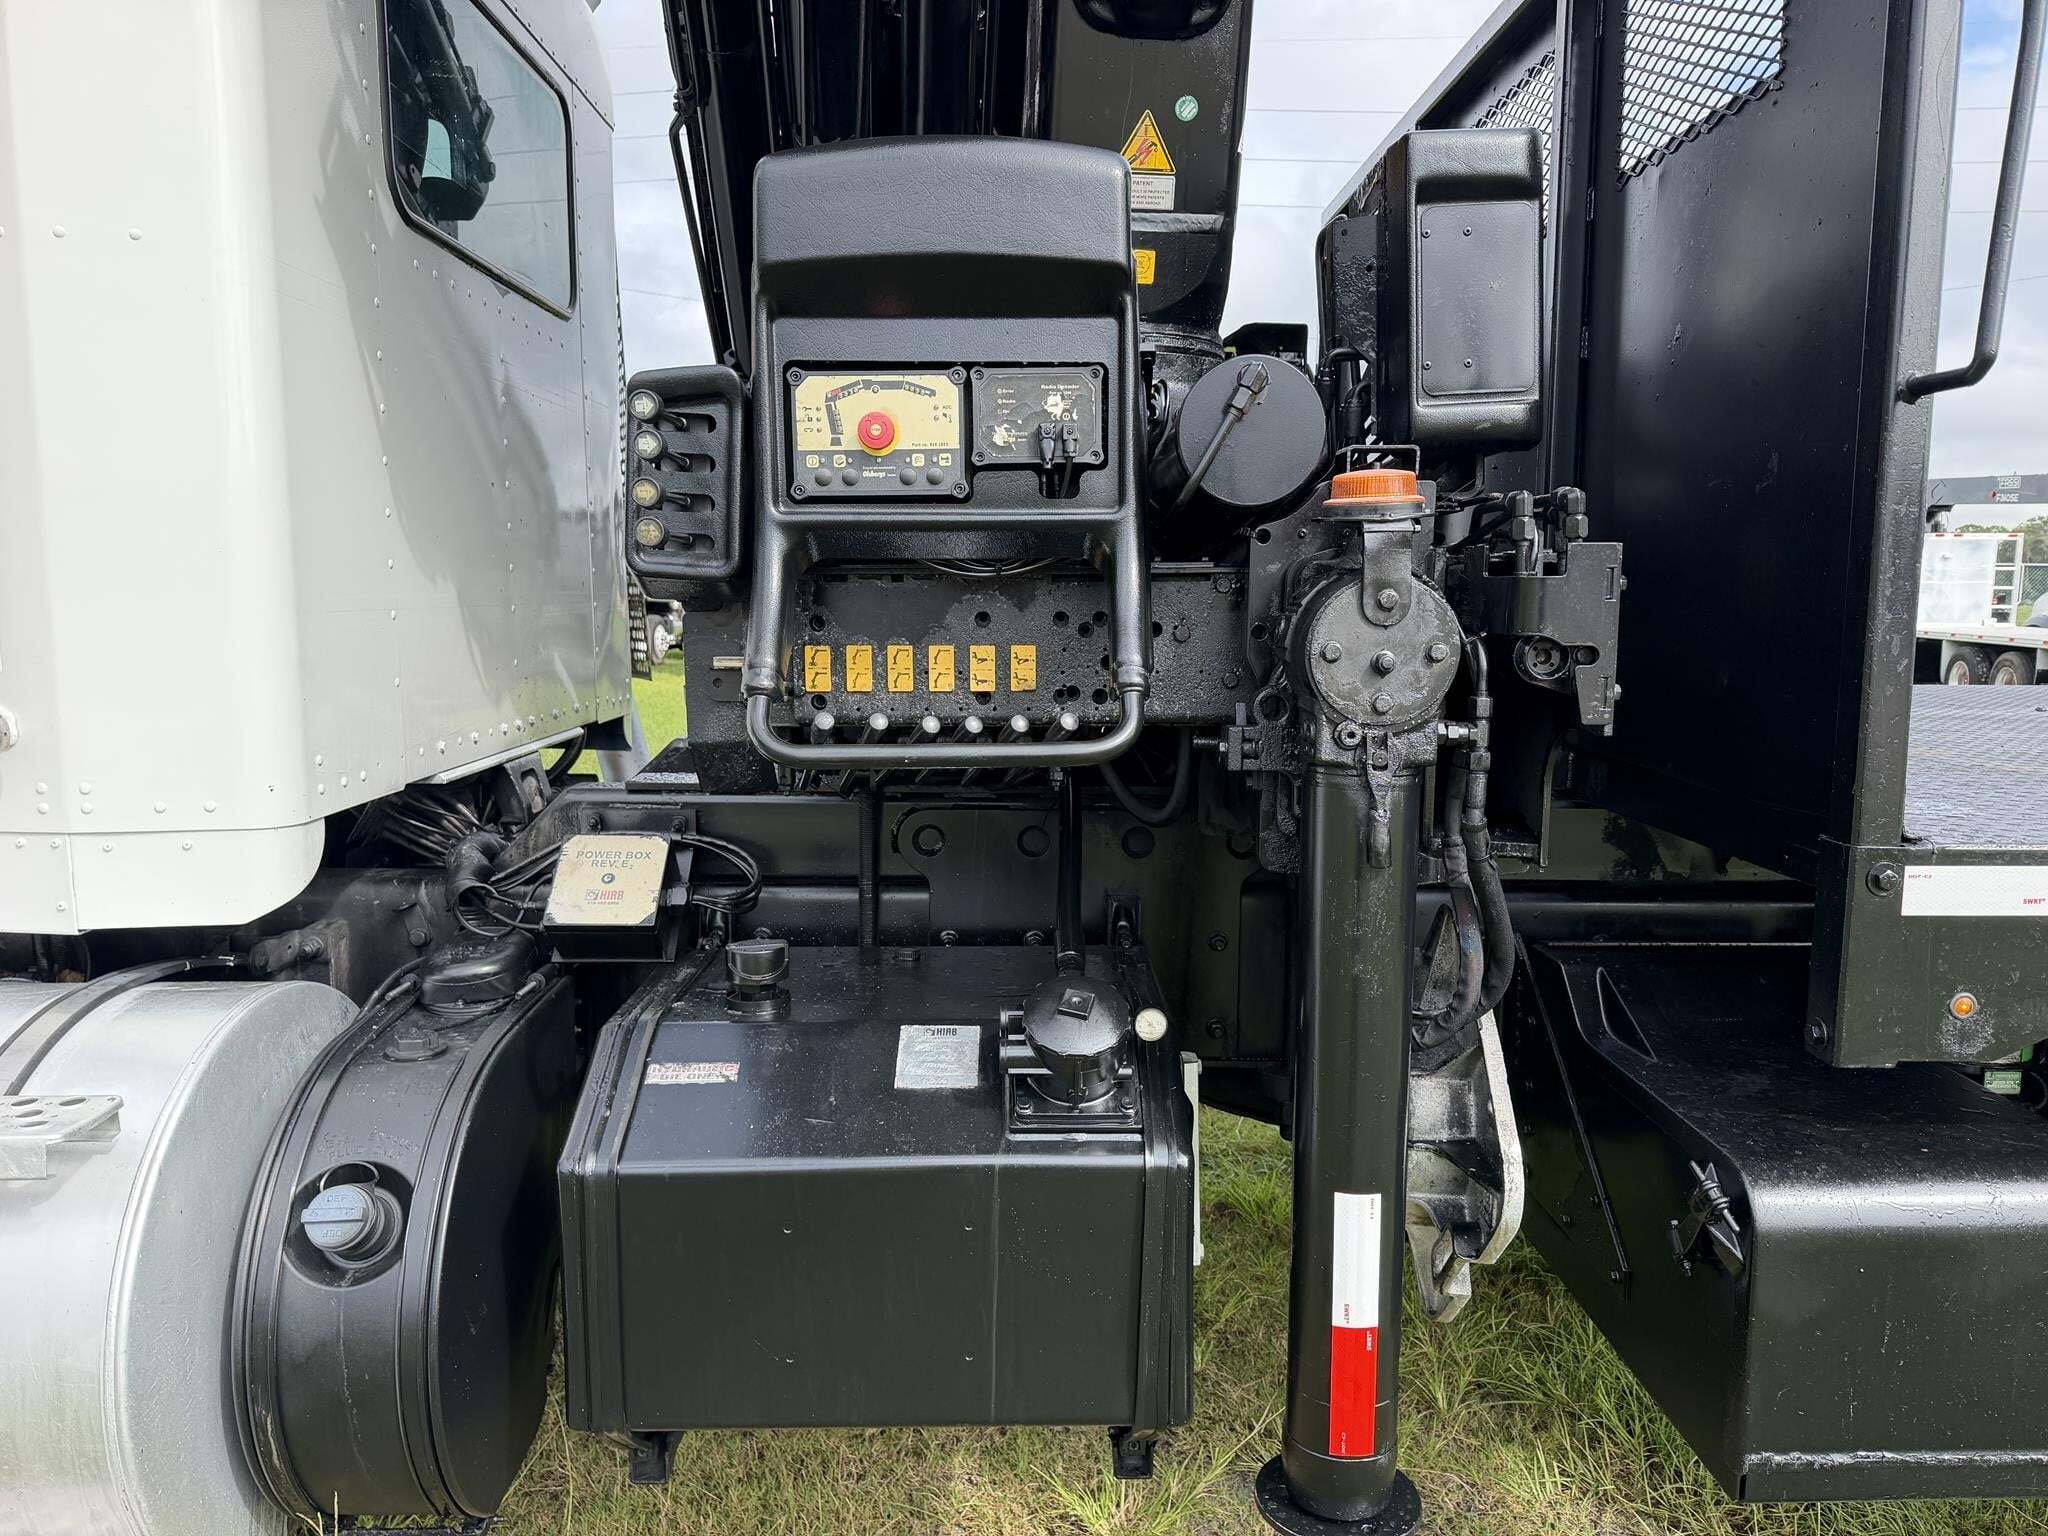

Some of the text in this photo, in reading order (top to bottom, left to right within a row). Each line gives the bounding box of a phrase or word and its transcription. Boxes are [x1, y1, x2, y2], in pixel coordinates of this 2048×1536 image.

[576, 851, 652, 860] POWER BOX
[599, 889, 625, 901] HIAB
[936, 1027, 958, 1037] HIAB
